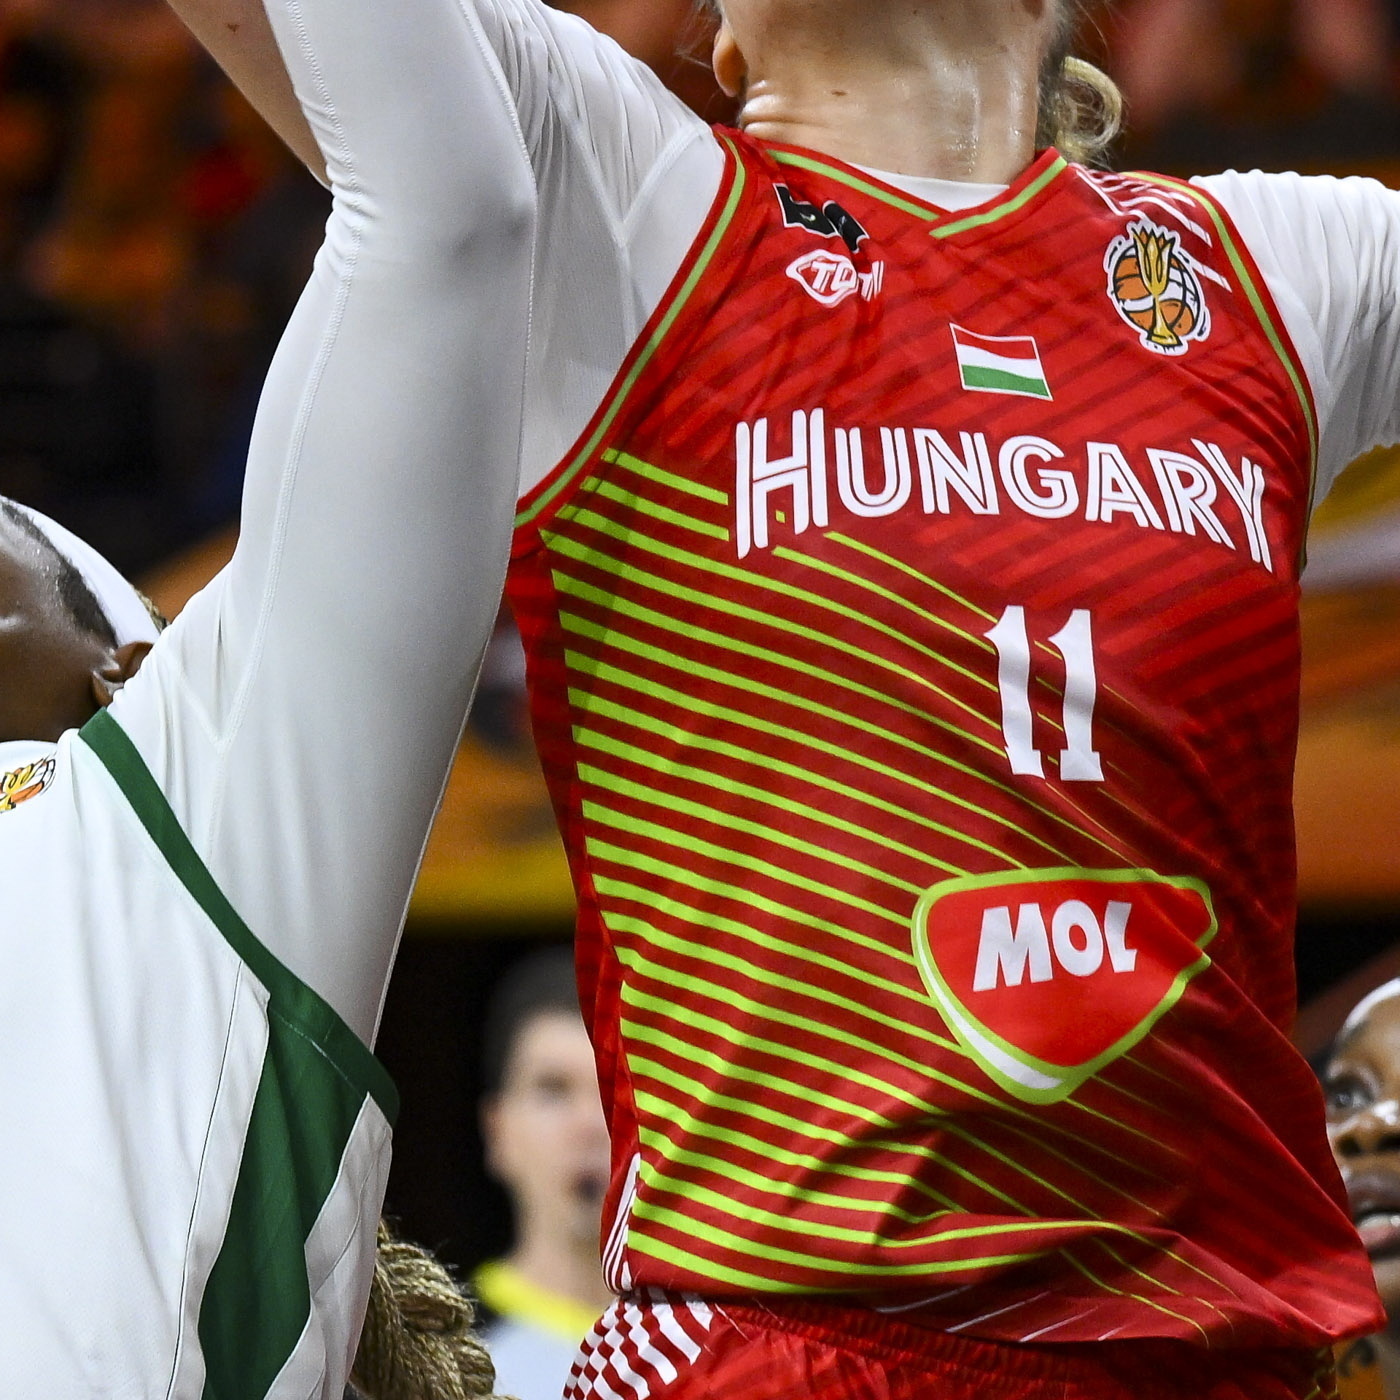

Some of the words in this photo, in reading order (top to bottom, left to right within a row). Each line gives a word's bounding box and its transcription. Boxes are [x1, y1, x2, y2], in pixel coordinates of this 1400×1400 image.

[734, 407, 1274, 573] HUNGARY
[982, 604, 1106, 783] 11
[972, 899, 1138, 993] MOL
